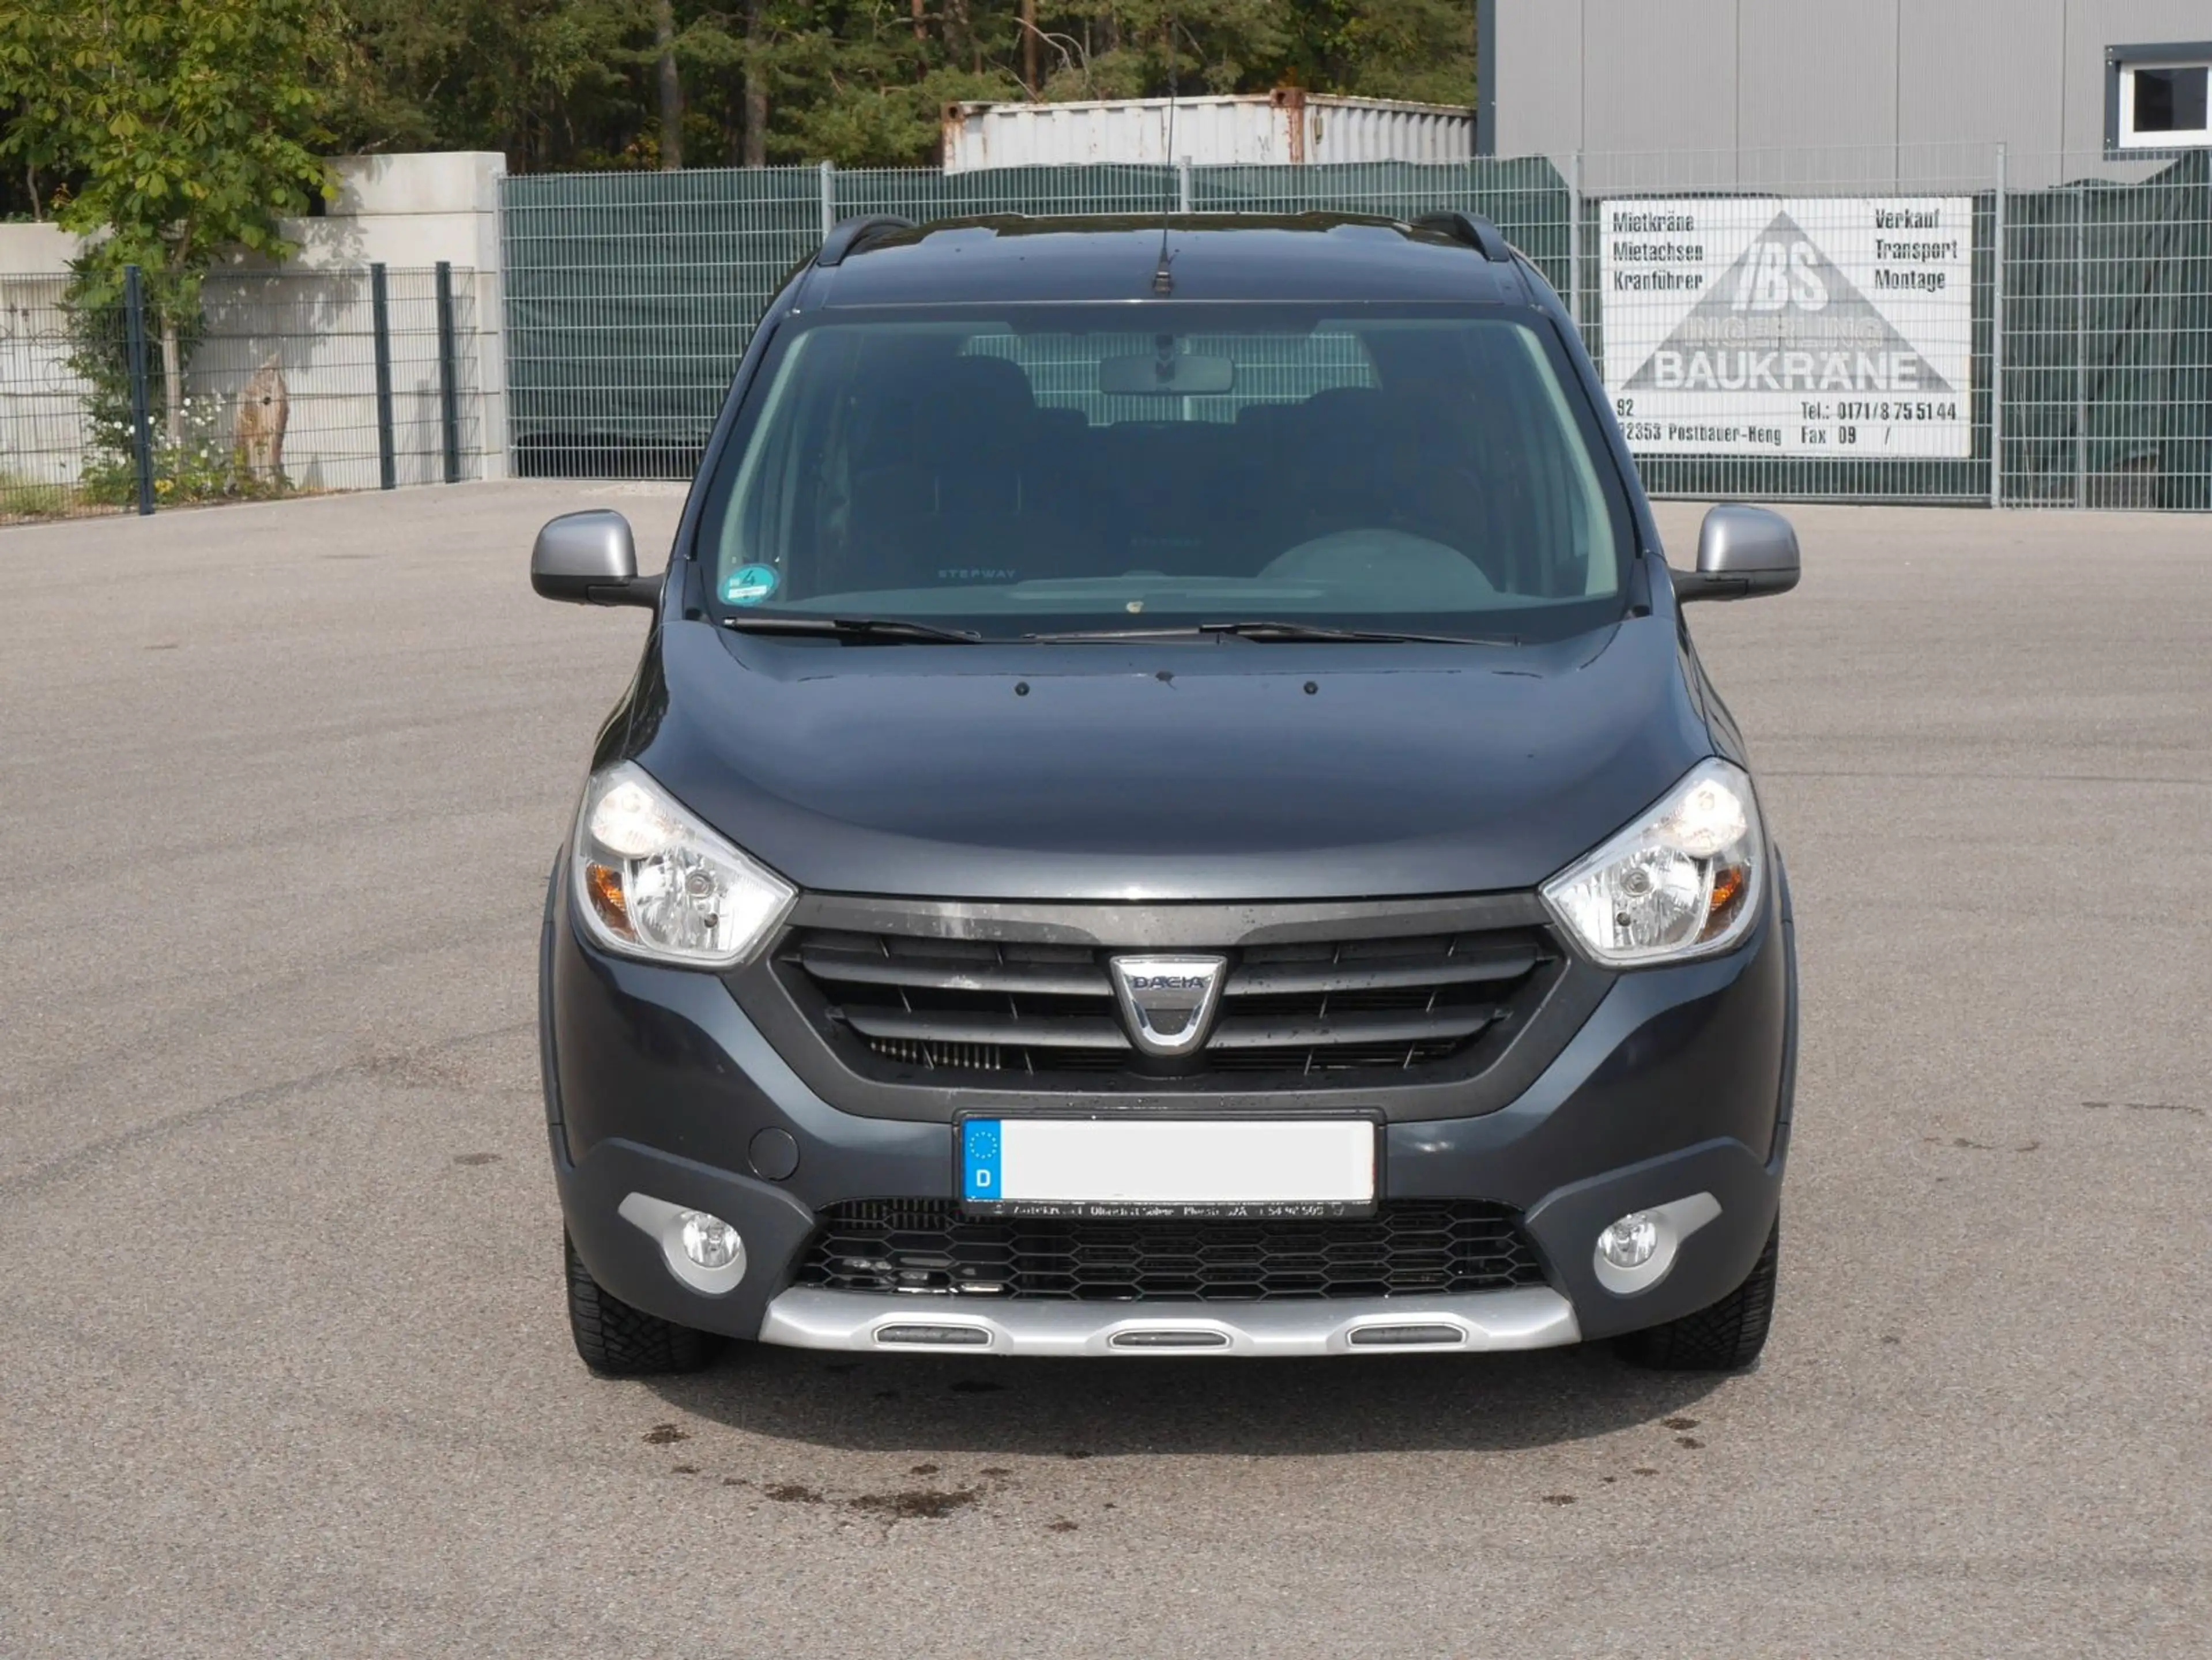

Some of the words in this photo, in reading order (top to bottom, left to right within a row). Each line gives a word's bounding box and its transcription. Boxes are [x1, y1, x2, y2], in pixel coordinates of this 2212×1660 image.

[1614, 210, 1694, 232] Mietkräne
[1875, 208, 1940, 228] Verkauf
[1614, 242, 1704, 261] Mietachsen
[1875, 239, 1958, 262] Transport
[1614, 270, 1703, 290] Kranführer
[1731, 241, 1829, 311] IBS
[1875, 269, 1946, 292] Montage
[1655, 350, 1919, 390] BAUKRÄNE
[1801, 402, 1830, 420] Tel.:
[1668, 424, 1782, 446] Postbauer-Heng
[1801, 426, 1826, 444] Fax
[1838, 426, 1856, 444] 09
[742, 570, 755, 586] 4
[1133, 976, 1205, 989] DACIA
[977, 1169, 991, 1187] D
